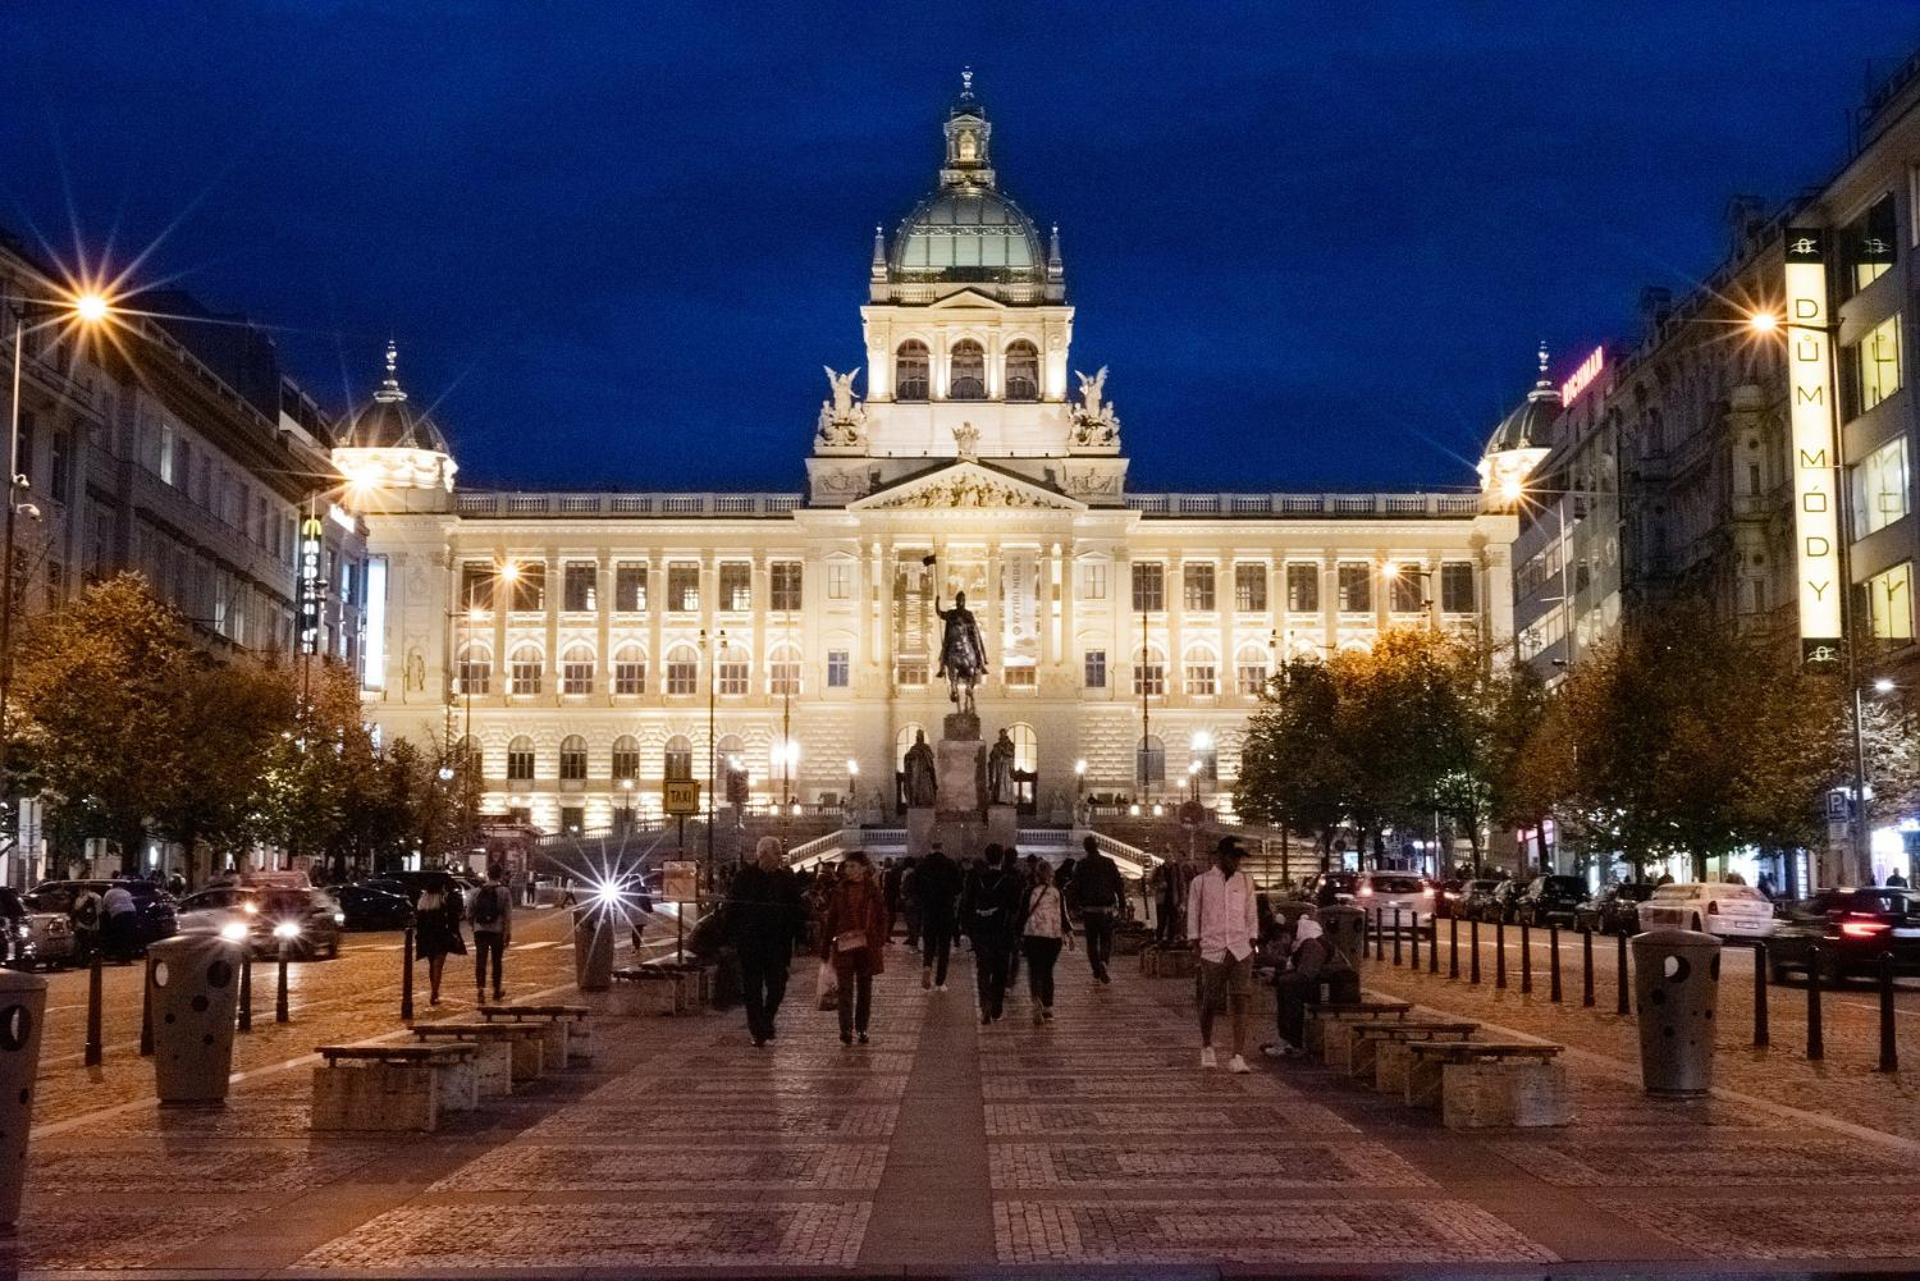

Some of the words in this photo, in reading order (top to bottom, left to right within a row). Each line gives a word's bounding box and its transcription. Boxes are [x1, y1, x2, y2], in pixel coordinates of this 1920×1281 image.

[1796, 298, 1823, 406] DŮM
[1800, 449, 1829, 601] MÓDY
[670, 789, 692, 804] TAXI
